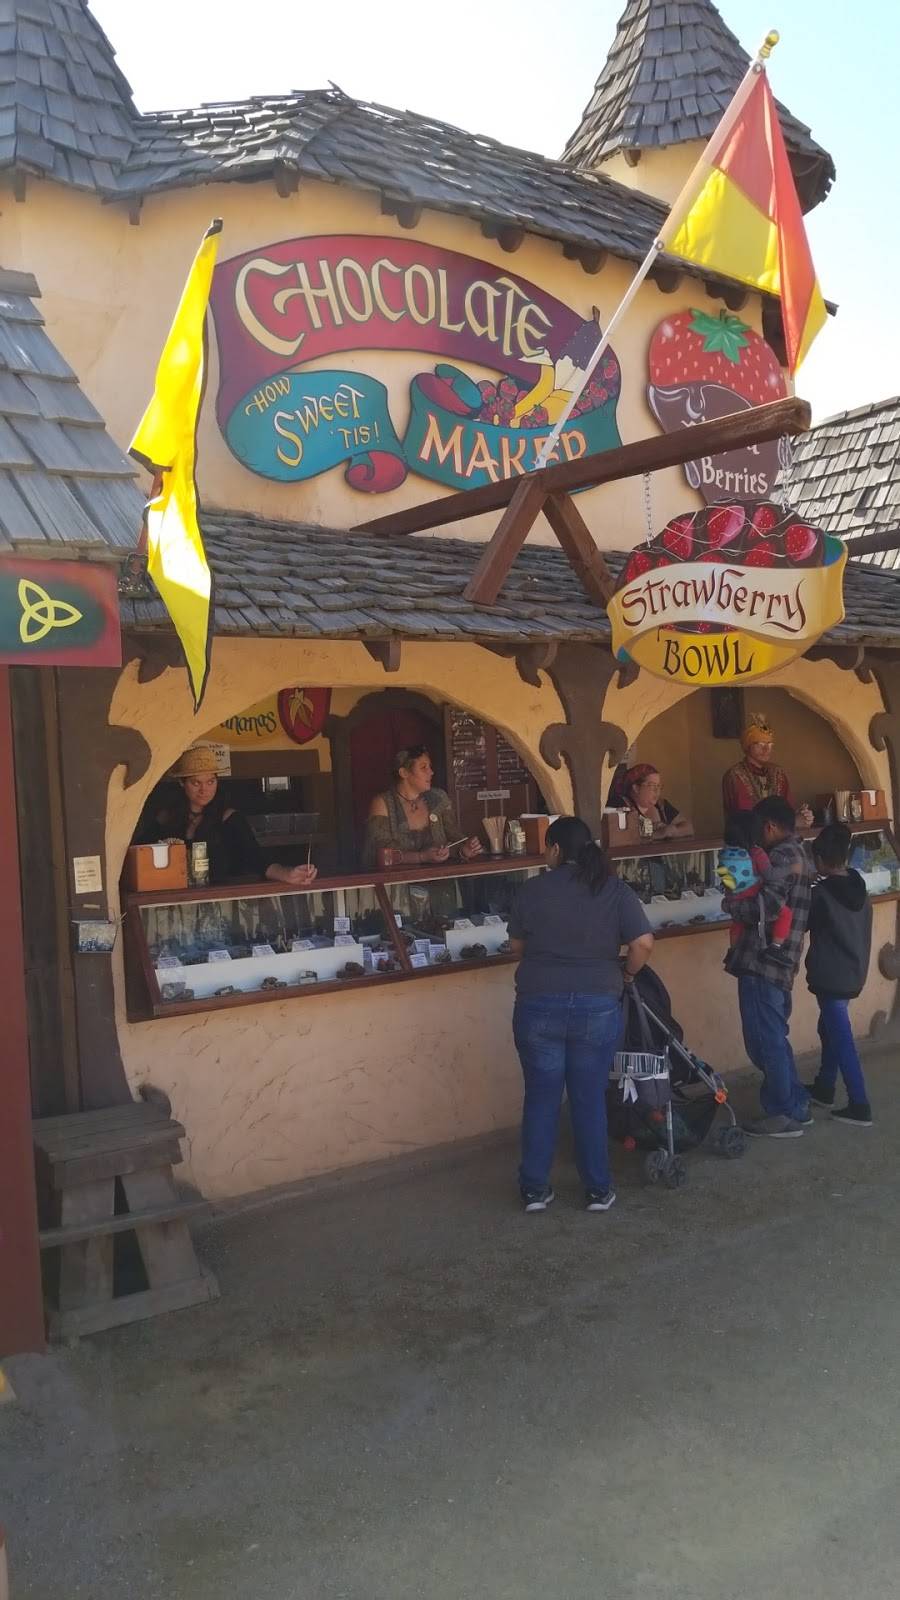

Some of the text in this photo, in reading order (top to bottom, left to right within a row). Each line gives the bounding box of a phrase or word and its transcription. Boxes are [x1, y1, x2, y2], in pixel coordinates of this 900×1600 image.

[245, 376, 291, 416] HOW
[274, 384, 366, 467] SWEET
[701, 456, 768, 495] Berries
[620, 569, 806, 633] Strawberry
[661, 634, 756, 677] BOWL
[220, 711, 277, 737] ananas
